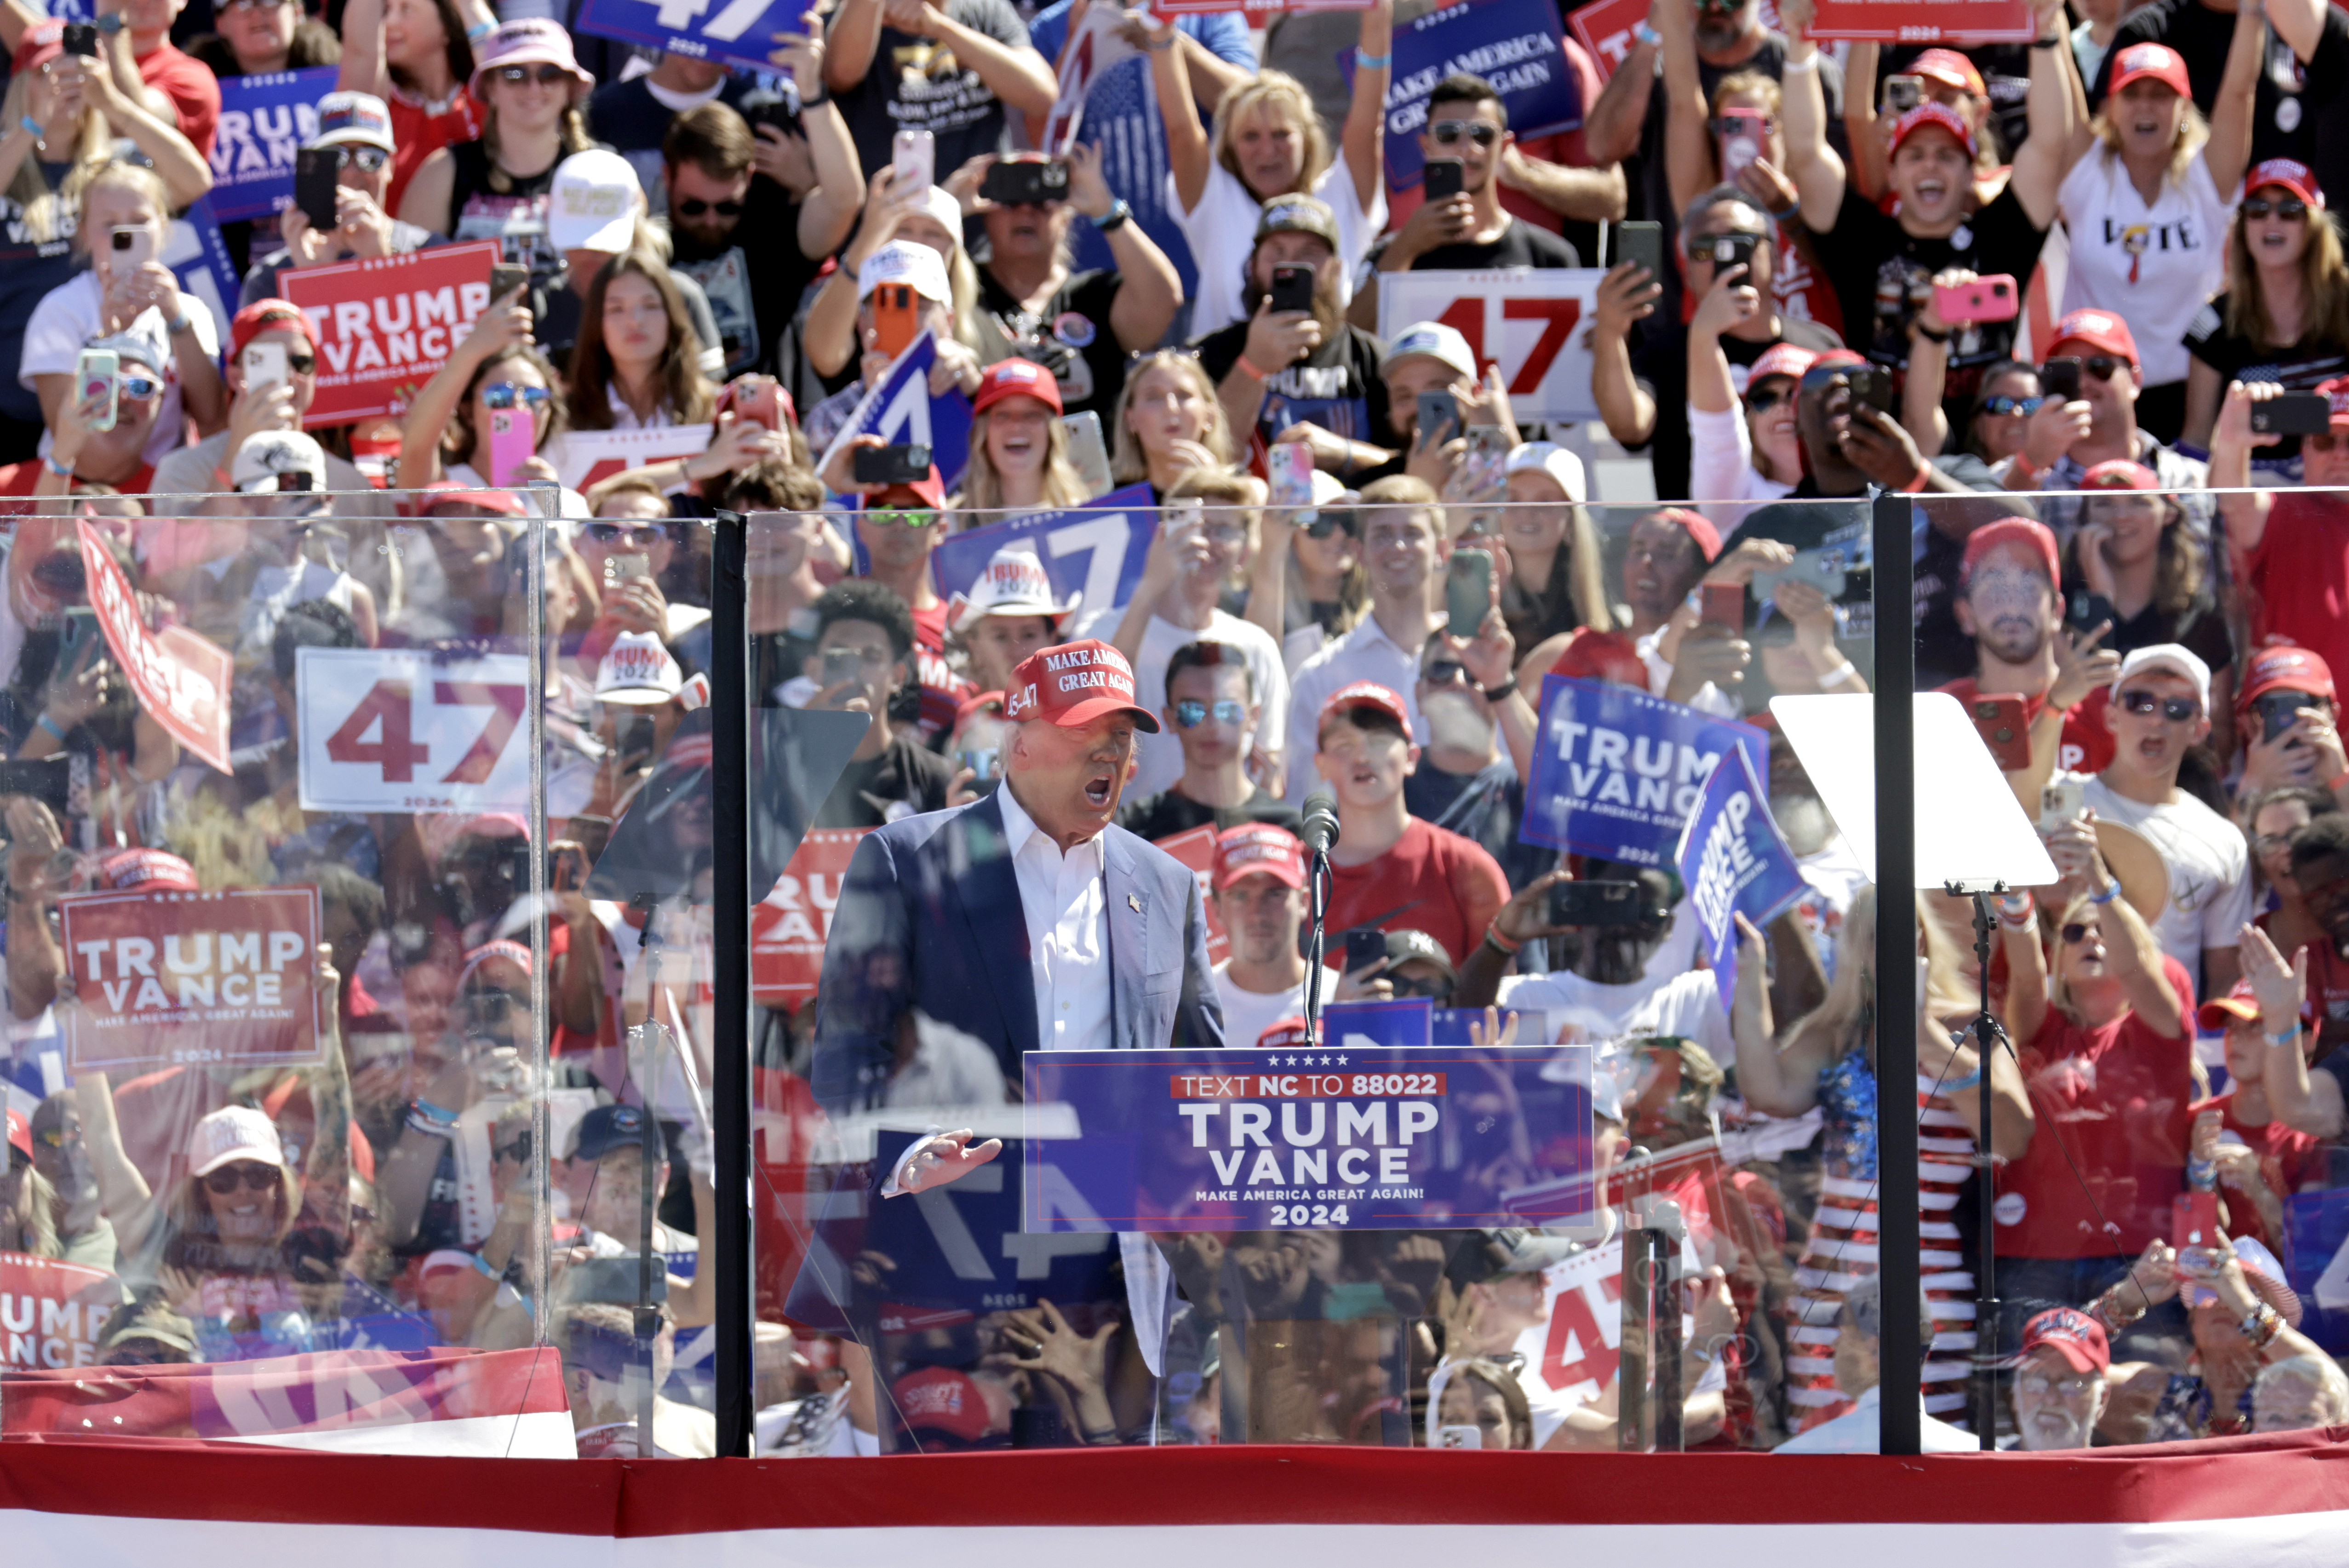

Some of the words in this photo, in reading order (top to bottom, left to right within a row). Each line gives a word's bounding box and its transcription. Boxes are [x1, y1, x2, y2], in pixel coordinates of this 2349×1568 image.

[1898, 25, 1941, 40] 2024
[1383, 65, 1439, 110] AKE
[1444, 31, 1557, 79] AMERICA
[1486, 59, 1552, 96] GAIN
[218, 102, 320, 155] RUM
[209, 137, 298, 177] VAN
[302, 281, 491, 346] TRUMP
[1268, 365, 1348, 399] RUMP
[985, 563, 1048, 585] TRUMP
[1003, 511, 1132, 612] 7
[1046, 650, 1091, 672] MAKE
[1059, 671, 1106, 692] GREAT
[1007, 683, 1037, 717] 45-47
[326, 678, 526, 784] 47
[1551, 718, 1720, 784] TRUM
[403, 797, 455, 807] 2024
[1570, 761, 1700, 819] VANC
[1553, 795, 1589, 812] MAKE
[1590, 800, 1650, 824] AMERICA
[1616, 844, 1660, 864] 2024
[76, 931, 305, 981] TRUMP
[102, 973, 281, 1013] VANCE
[95, 1014, 128, 1029] MAKE
[130, 1012, 201, 1025] AMERICA
[206, 1009, 245, 1022] GREAT
[250, 1008, 294, 1020] AGAIN!
[172, 1048, 223, 1063] 2024
[1180, 1076, 1250, 1097] TEXT
[1259, 1076, 1299, 1096] NC
[1306, 1075, 1343, 1096] TO
[1352, 1074, 1437, 1095] 88022
[1178, 1101, 1439, 1147] TRUMP
[1209, 1148, 1409, 1186] VANCE
[1196, 1190, 1238, 1202] MAKE
[1243, 1190, 1312, 1201] AMERICA
[1316, 1189, 1366, 1200] GREAT
[1370, 1188, 1424, 1200] AGAIN!
[1270, 1204, 1349, 1226] 2024
[1, 1292, 112, 1343] UMP
[2035, 1311, 2092, 1340] MAGA
[0, 1332, 96, 1369] NCE
